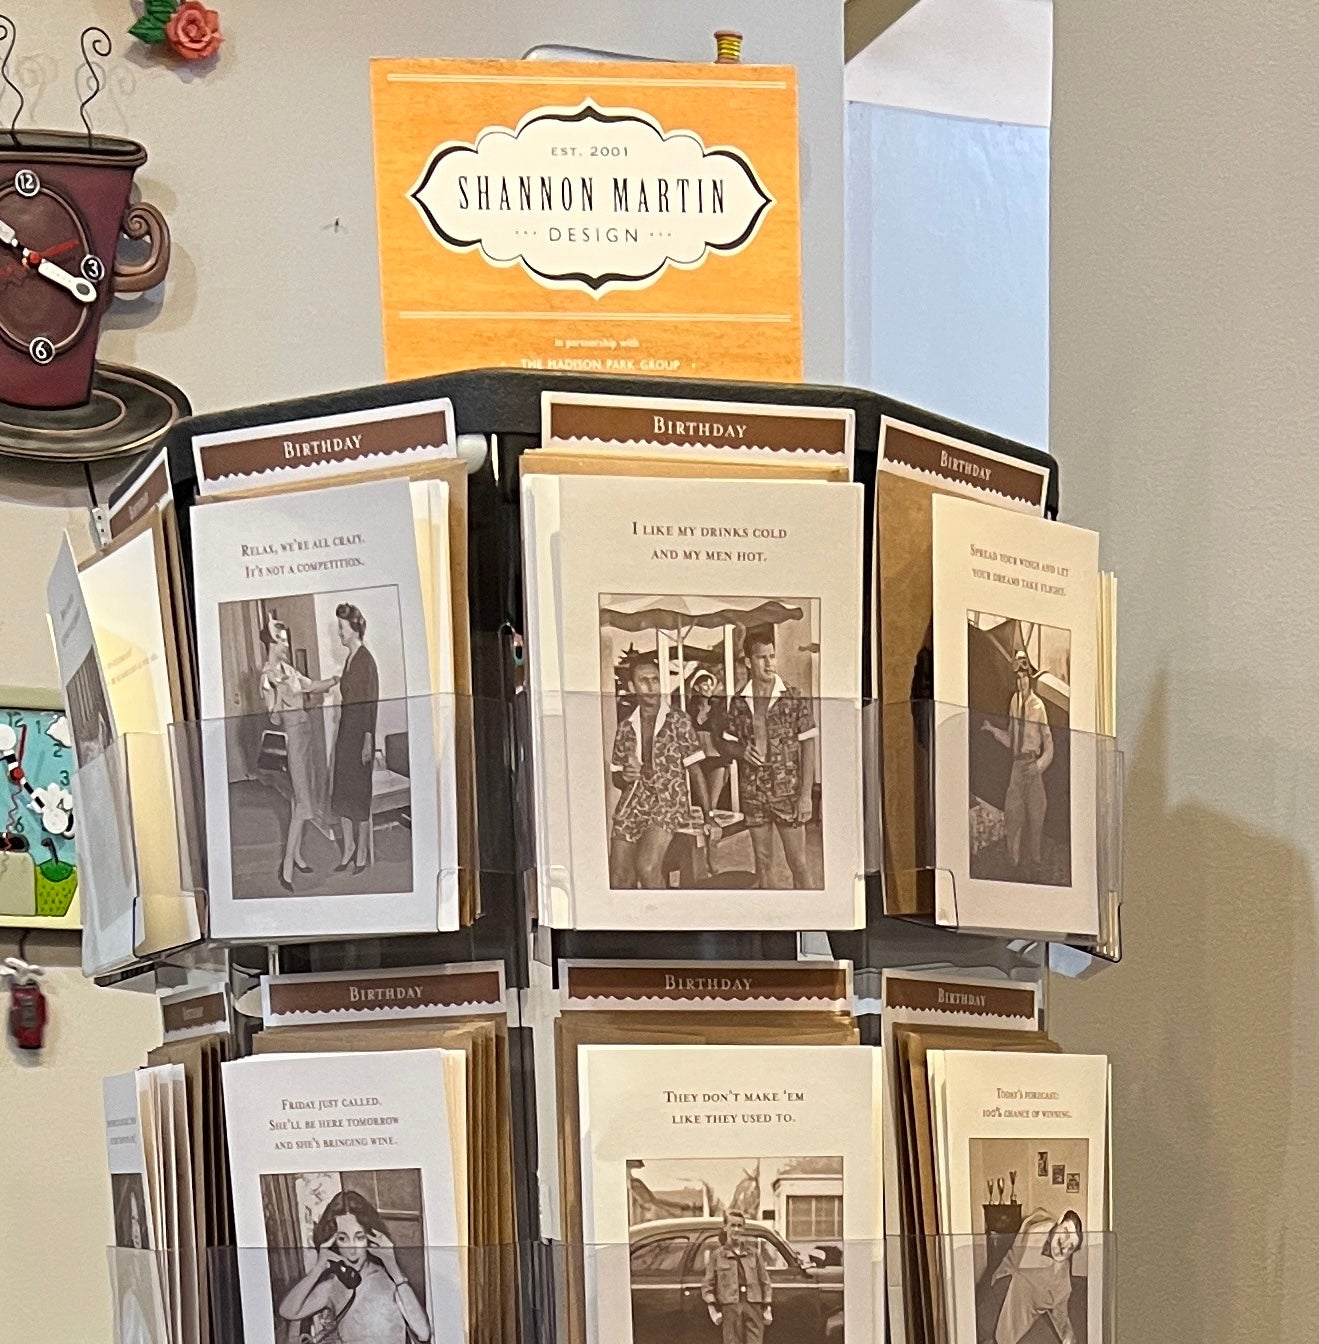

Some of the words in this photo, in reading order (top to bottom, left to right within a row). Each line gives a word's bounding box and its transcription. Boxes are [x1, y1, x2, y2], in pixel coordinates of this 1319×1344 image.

[552, 147, 582, 157] EST.
[590, 146, 629, 157] 2001
[19, 175, 35, 191] 12
[458, 176, 593, 211] SHANNON
[613, 177, 724, 213] MARTIN
[549, 228, 638, 243] DESIGN
[86, 259, 99, 277] 3
[36, 342, 46, 359] 6
[548, 359, 599, 370] MADISON
[606, 360, 634, 370] PARK
[640, 360, 680, 371] GROUP
[653, 416, 747, 438] BIRTHDAY
[283, 435, 362, 459] BIRTHDAY
[940, 450, 992, 480] BIRTHDAY
[632, 522, 638, 536] I
[643, 524, 673, 536] LIKE
[678, 526, 696, 537] MY
[700, 526, 748, 538] DRINKS
[752, 528, 787, 539] COLD
[651, 549, 678, 560] AND
[683, 550, 700, 561] MY
[706, 550, 732, 562] MEN
[737, 551, 767, 562] HOT.
[266, 564, 285, 576] NOT
[60, 770, 70, 786] 3
[664, 974, 752, 991] BIRTHDAY
[350, 986, 424, 1002] BIRTHDAY
[938, 988, 987, 1007] BIRTHDAY
[664, 1090, 697, 1103] THEY
[702, 1090, 741, 1102] DON'T
[744, 1092, 779, 1102] MAKE
[783, 1089, 804, 1102] 'EM
[318, 1099, 339, 1111] JUST
[305, 1119, 316, 1129] BE
[319, 1118, 344, 1129] HERE
[672, 1114, 701, 1125] LIKE
[705, 1114, 737, 1124] THEY
[742, 1113, 772, 1124] USED
[776, 1112, 796, 1123] TO.
[274, 1141, 293, 1150] AND
